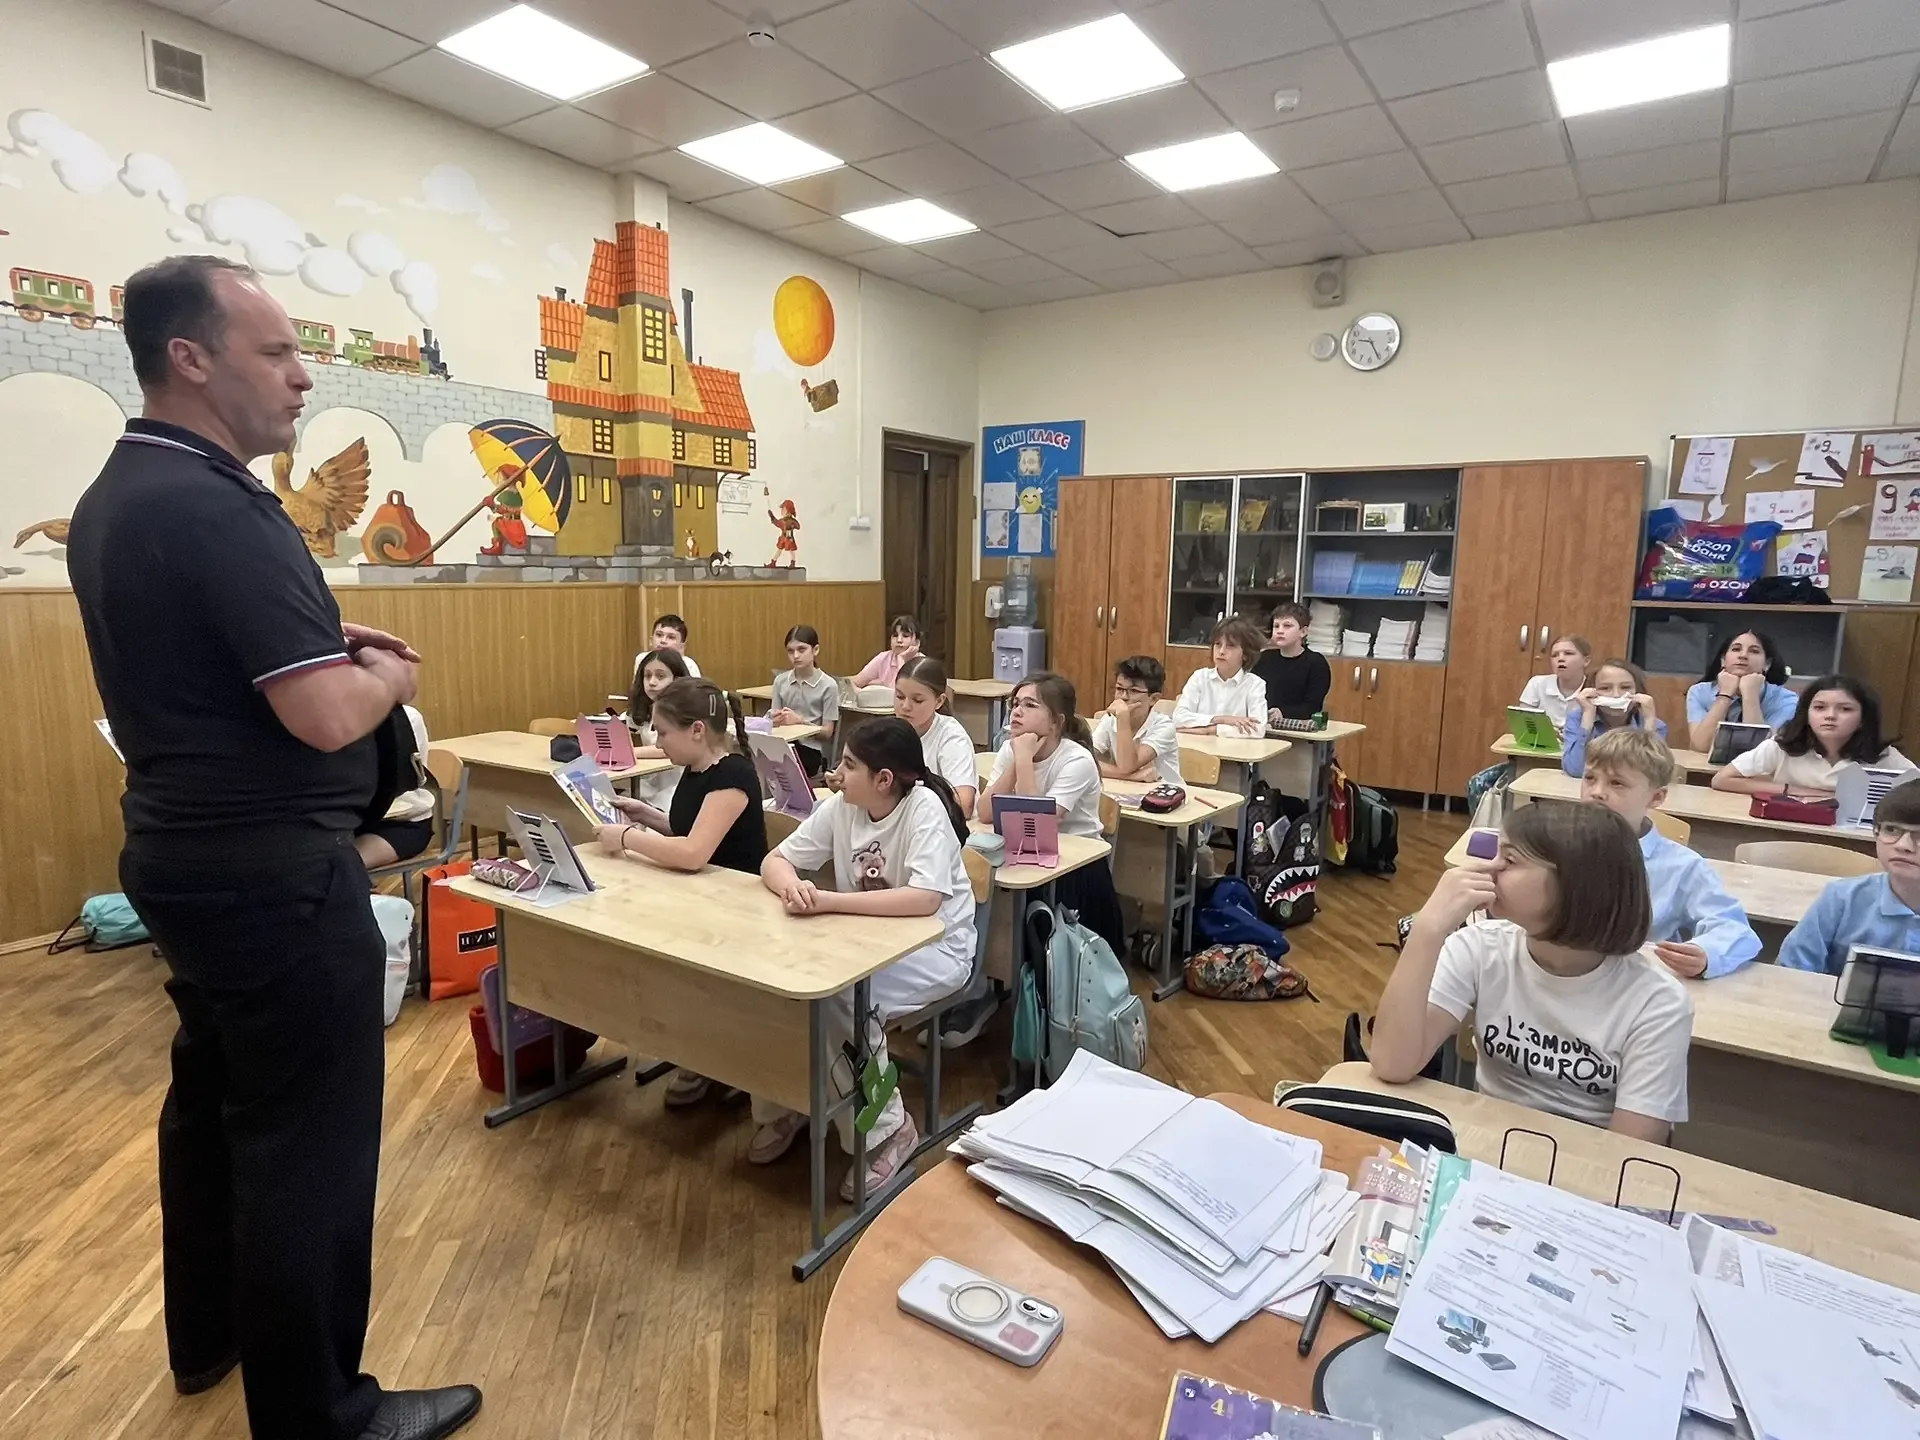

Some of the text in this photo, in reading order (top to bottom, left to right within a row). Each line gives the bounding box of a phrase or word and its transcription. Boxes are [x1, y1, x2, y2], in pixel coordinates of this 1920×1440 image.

[993, 428, 1071, 454] НАШ КЛАСС
[1880, 483, 1898, 514] 9
[1709, 580, 1750, 590] OZON
[1210, 1398, 1225, 1417] 4
